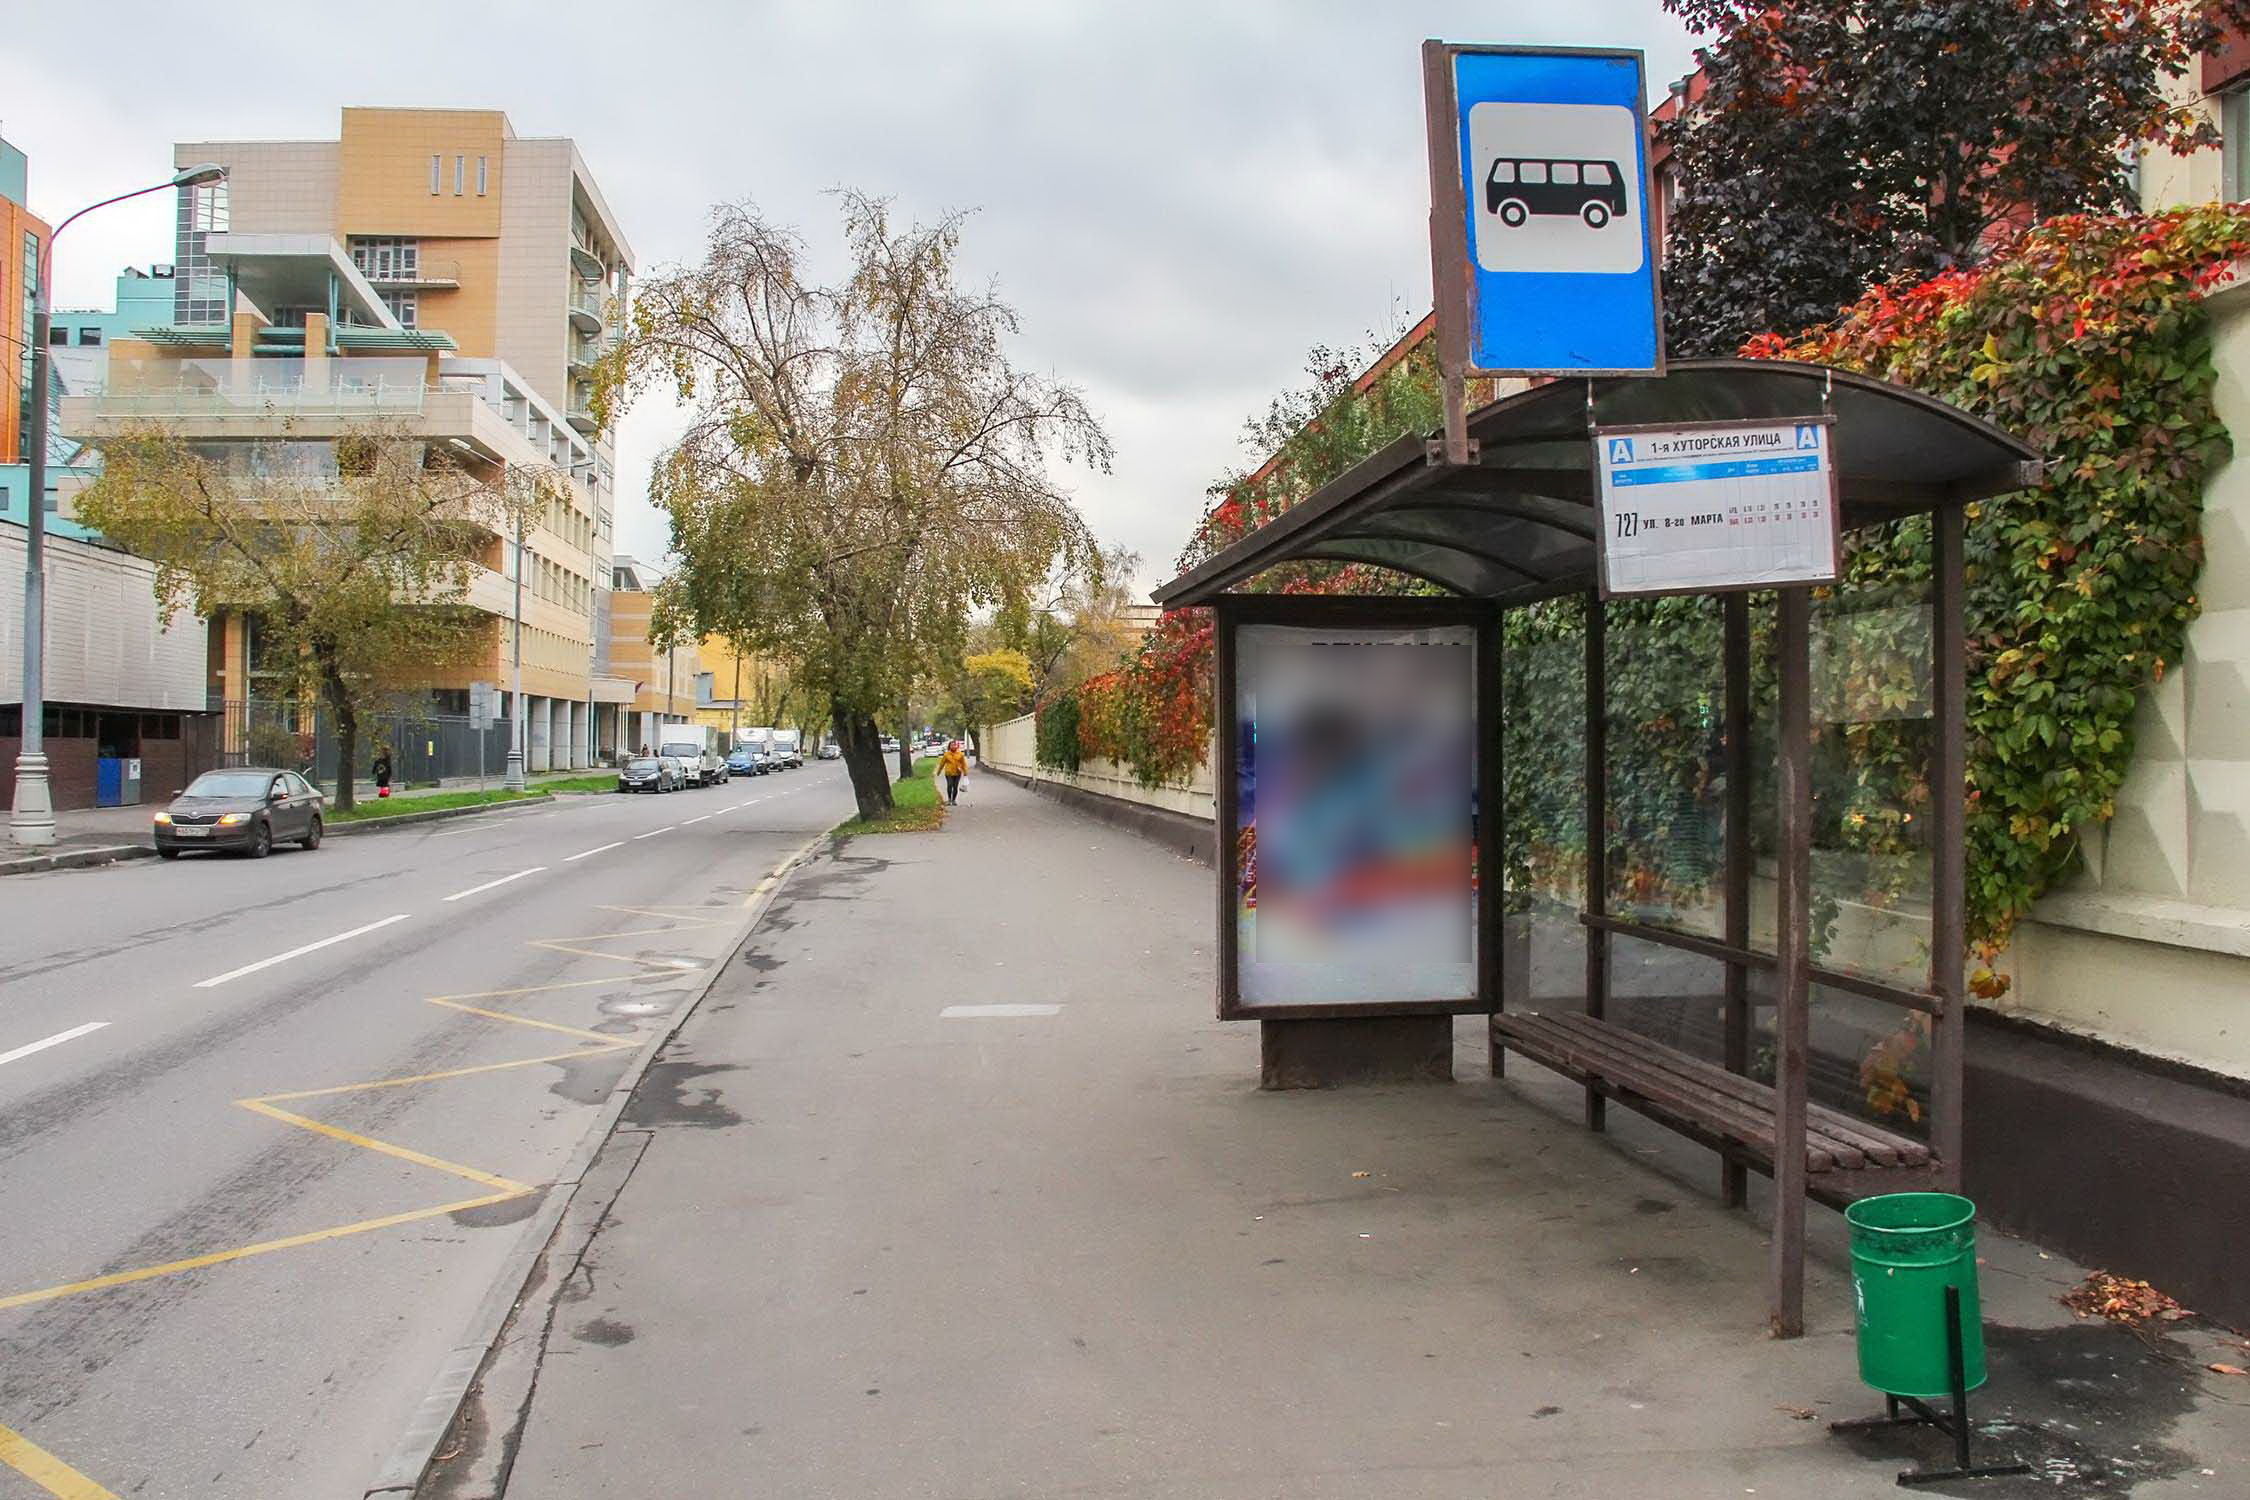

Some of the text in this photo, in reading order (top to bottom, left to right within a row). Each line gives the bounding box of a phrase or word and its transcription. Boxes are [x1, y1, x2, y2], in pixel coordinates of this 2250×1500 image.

[1651, 442, 1670, 454] 1-я
[1672, 435, 1740, 453] ХУТОРСКАЯ
[1742, 432, 1782, 447] УЛИЦА
[1615, 512, 1638, 538] 727
[1690, 513, 1724, 526] МАРТА
